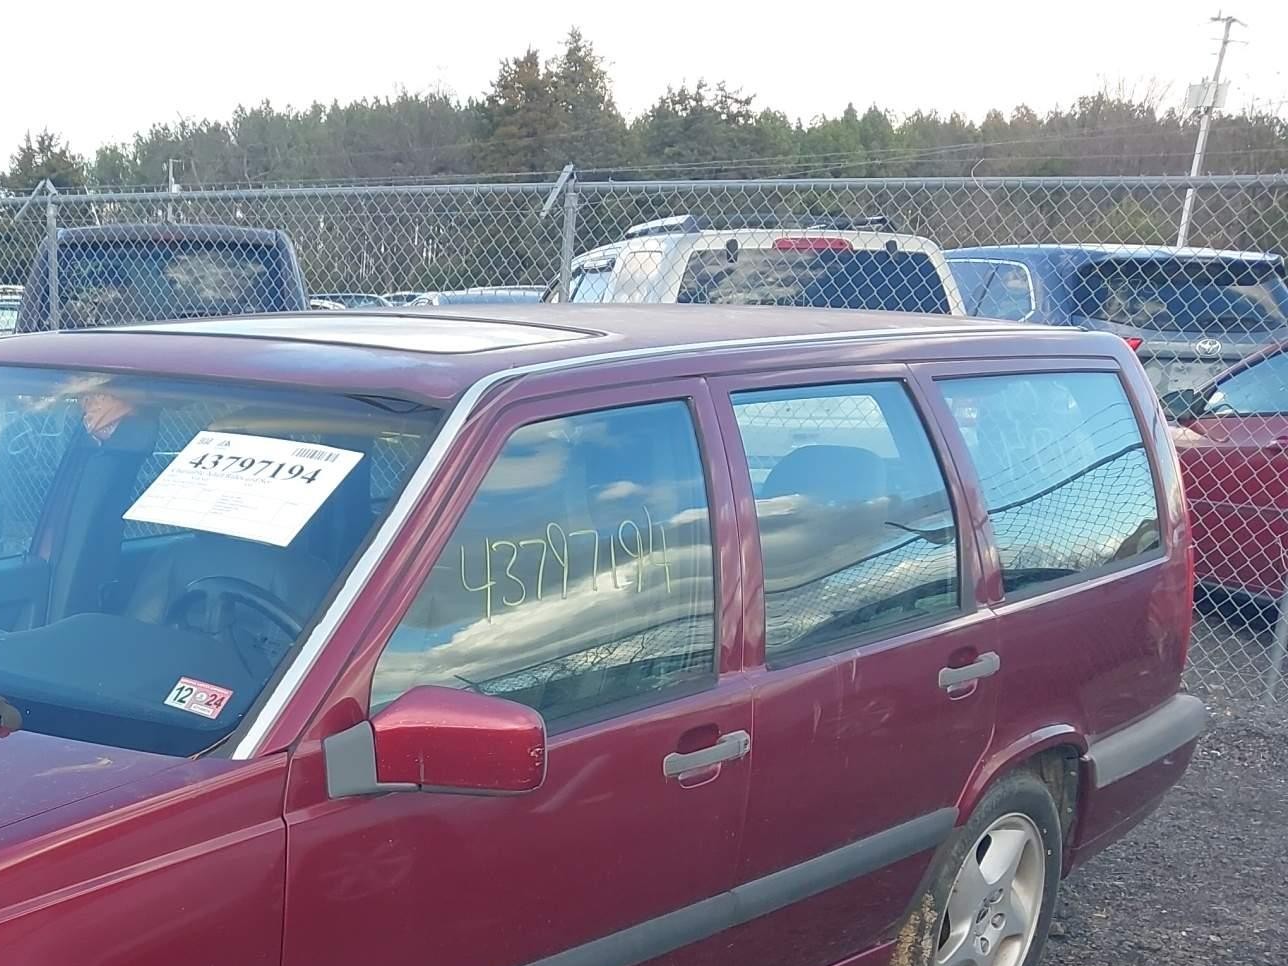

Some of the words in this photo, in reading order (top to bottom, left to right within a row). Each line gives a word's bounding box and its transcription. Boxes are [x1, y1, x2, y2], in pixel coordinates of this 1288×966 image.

[188, 453, 323, 484] 43797194
[460, 504, 673, 624] 43797194
[172, 685, 194, 704] 12
[204, 693, 225, 709] 24
